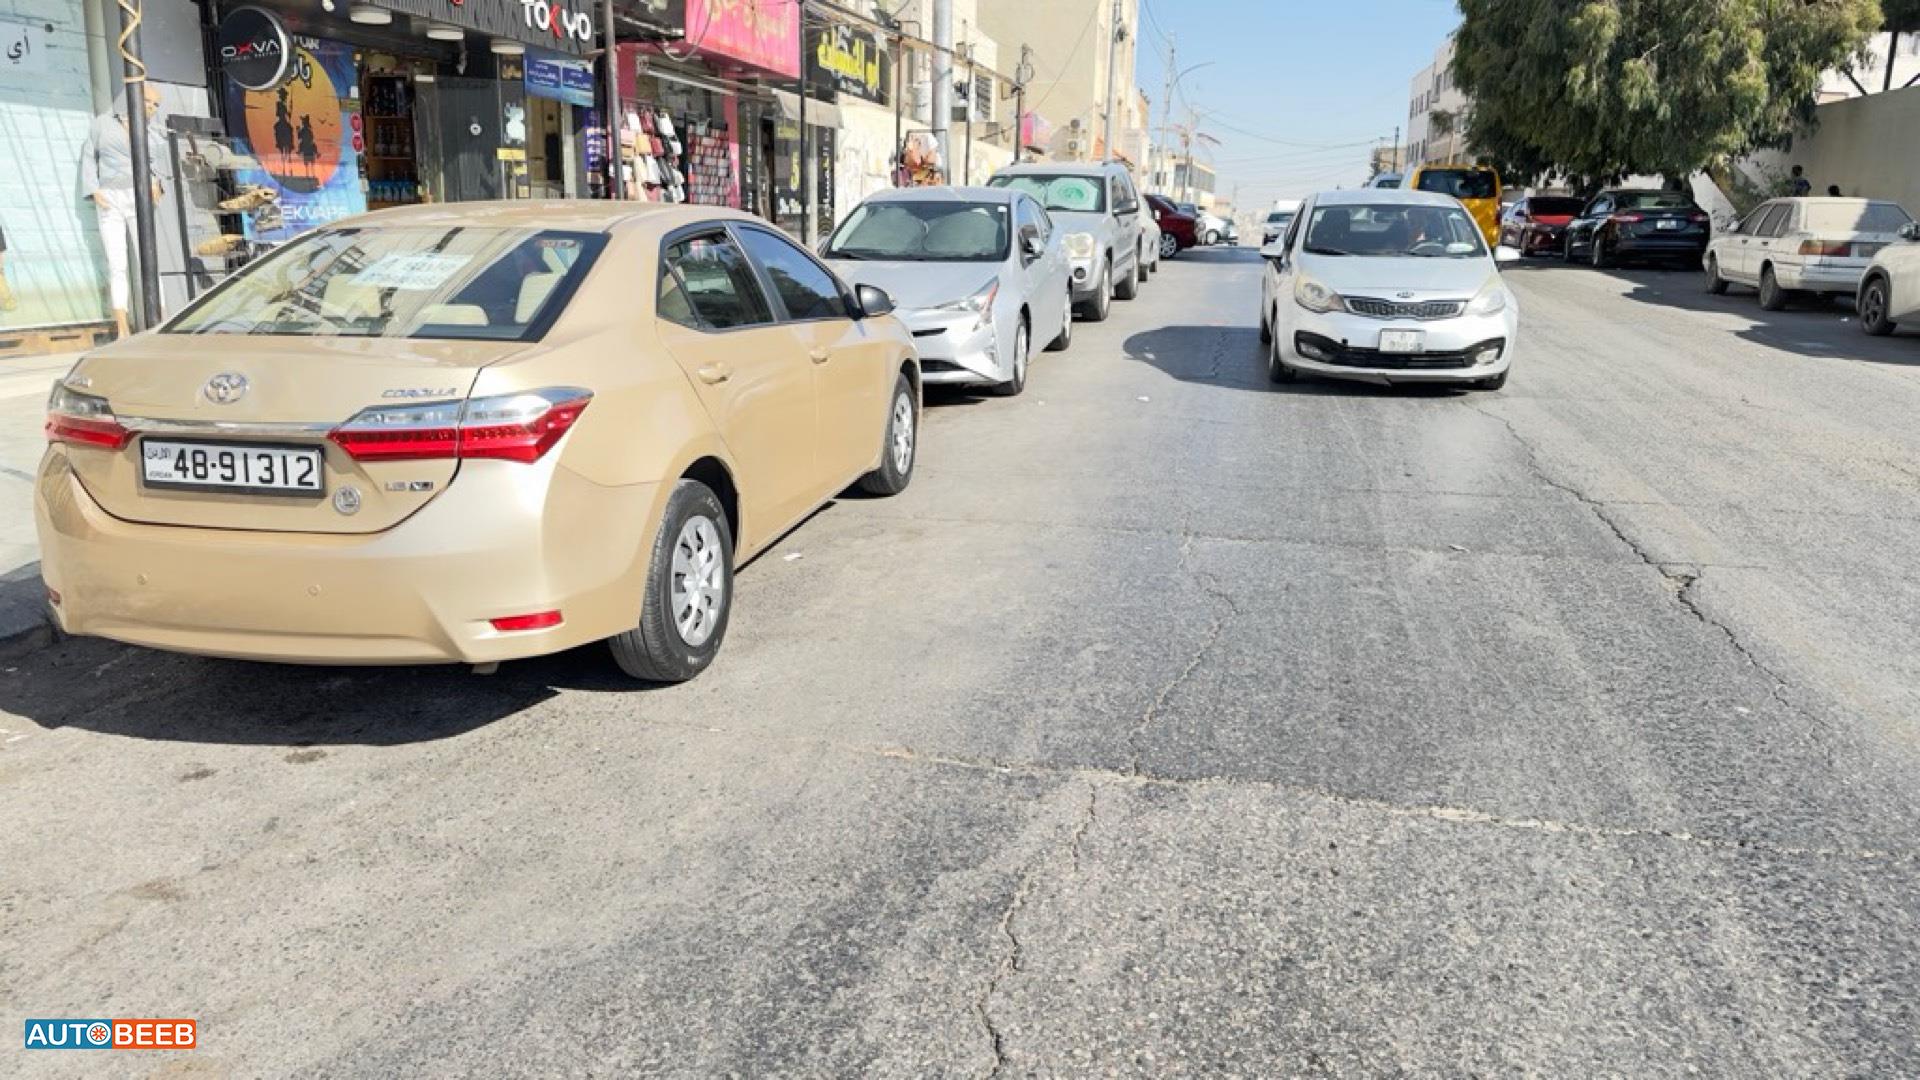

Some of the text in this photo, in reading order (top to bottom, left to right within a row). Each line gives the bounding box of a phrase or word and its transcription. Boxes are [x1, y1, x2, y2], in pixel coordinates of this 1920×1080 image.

[520, 0, 591, 41] TOKYO
[221, 38, 280, 56] OXVA
[381, 387, 457, 398] COROLLA
[174, 447, 315, 487] 48-91312
